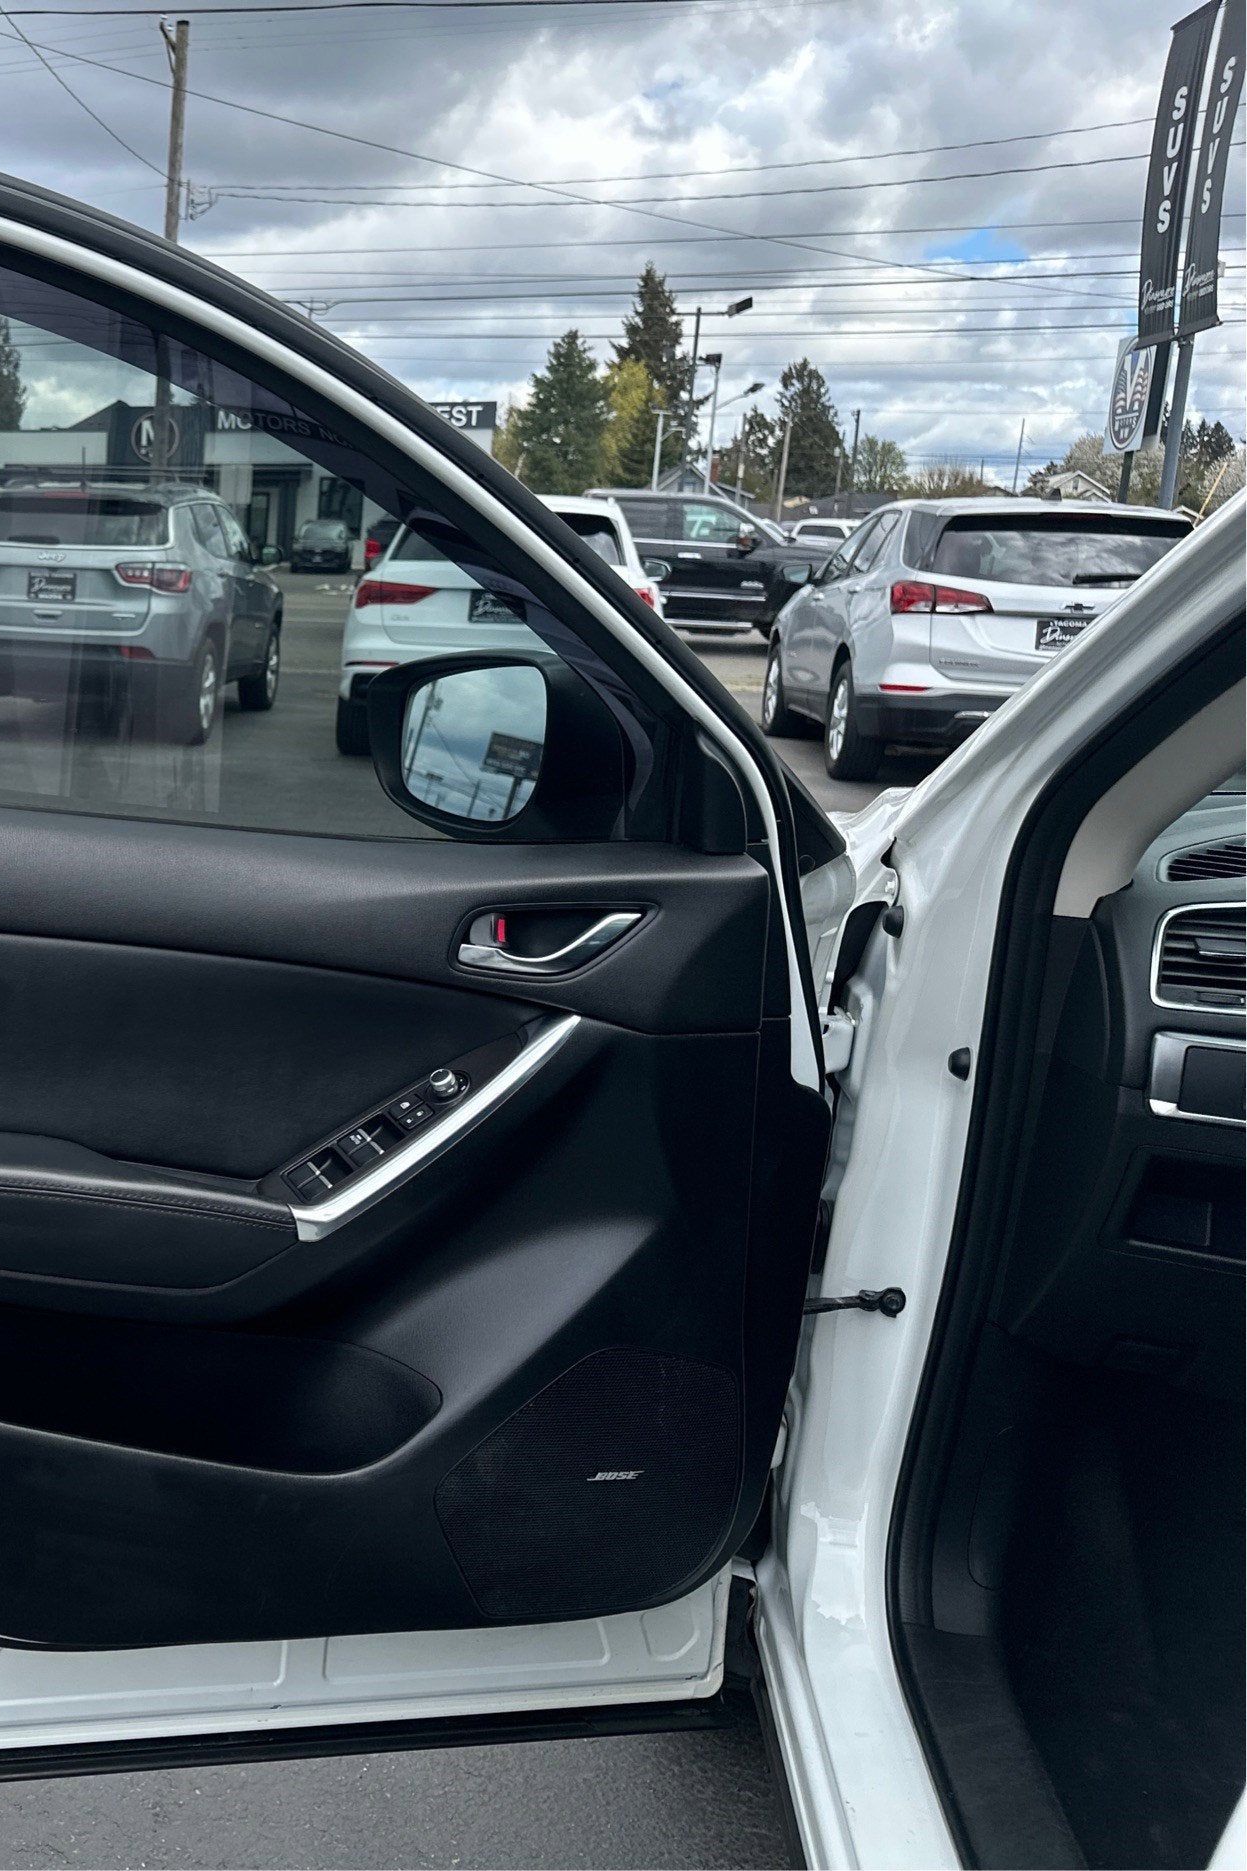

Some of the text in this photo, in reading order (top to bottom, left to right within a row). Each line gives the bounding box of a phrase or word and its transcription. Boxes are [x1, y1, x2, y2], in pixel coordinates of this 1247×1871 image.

[1157, 86, 1188, 233] SUVS
[1201, 57, 1237, 214] SUVS
[217, 406, 312, 436] MOTORS
[586, 1470, 645, 1481] BOSE
